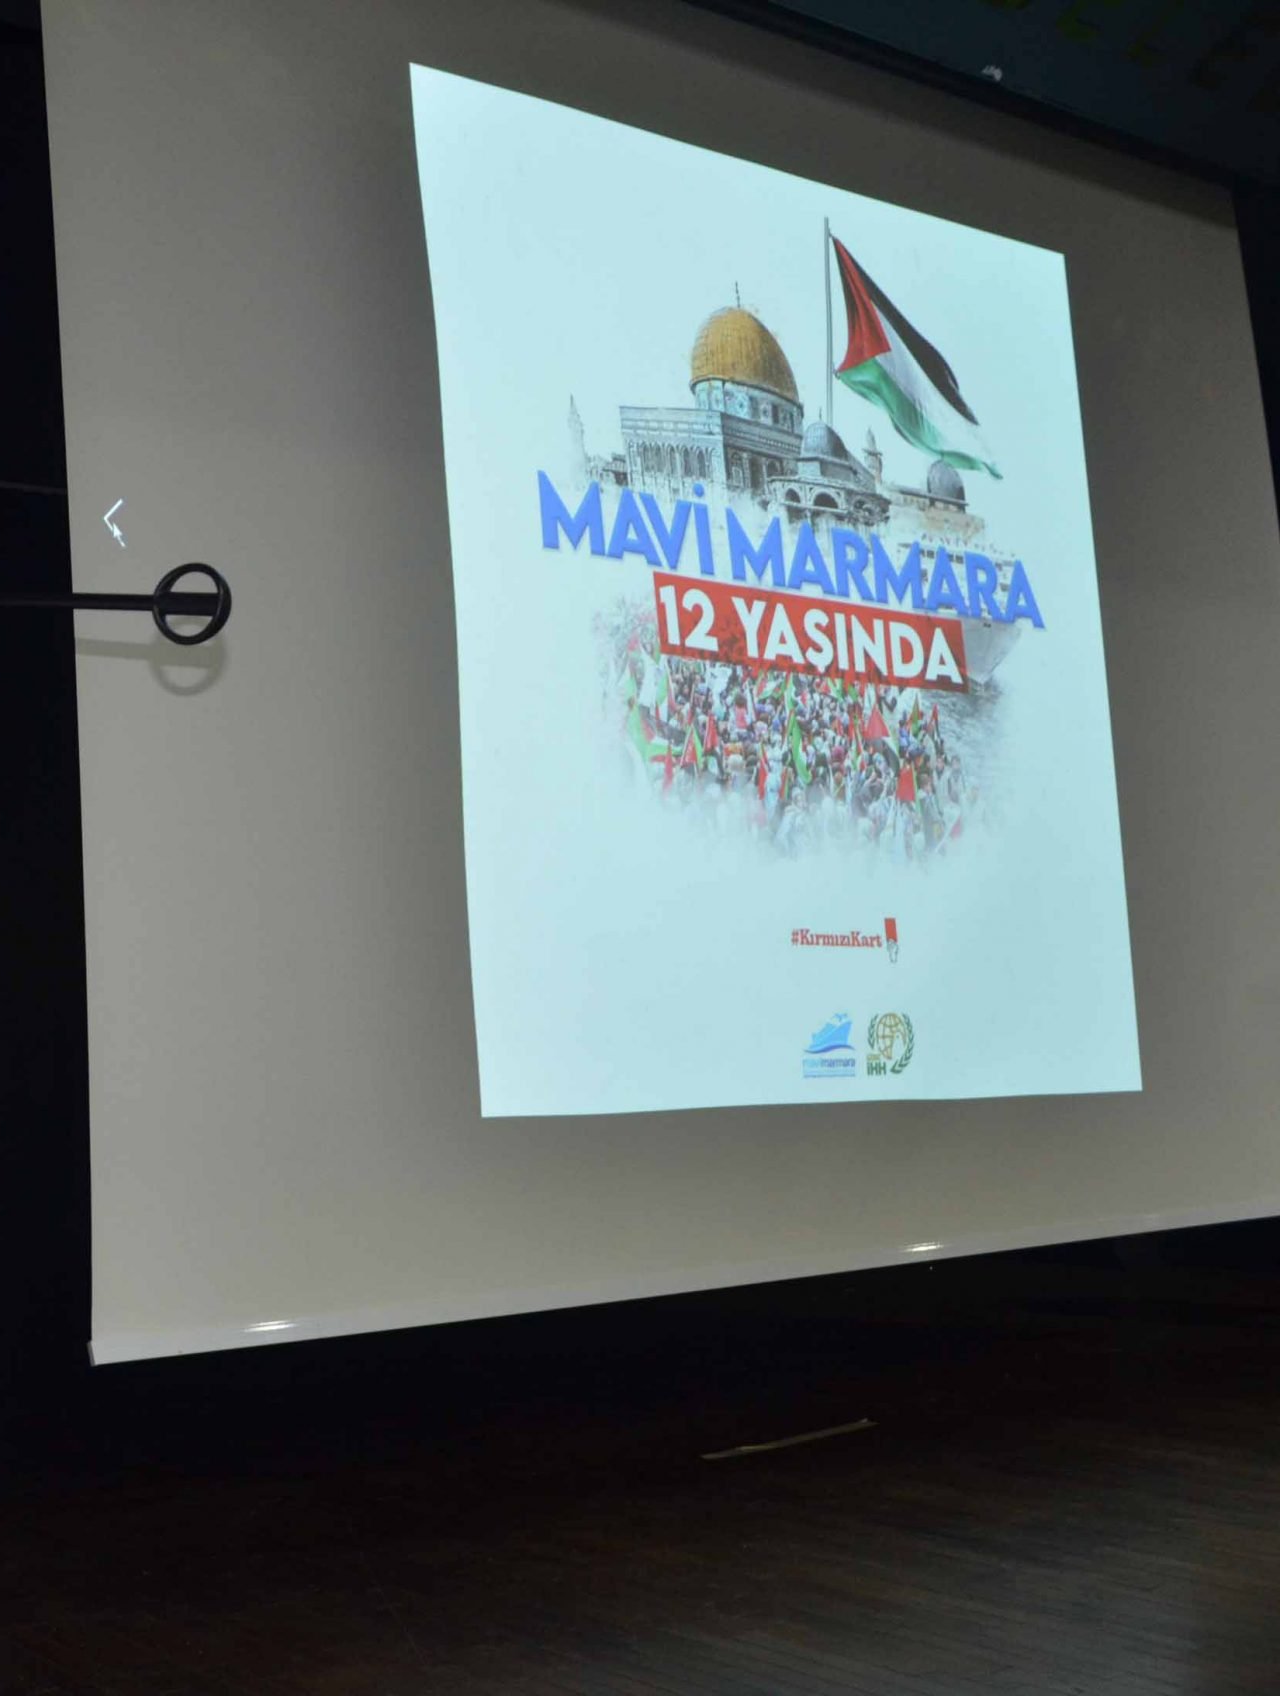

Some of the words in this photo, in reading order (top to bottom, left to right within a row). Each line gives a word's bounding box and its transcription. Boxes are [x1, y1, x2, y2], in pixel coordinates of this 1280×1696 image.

[725, 506, 1046, 630] MARMARA
[659, 584, 719, 652] 12
[731, 596, 963, 685] YAŞINDA
